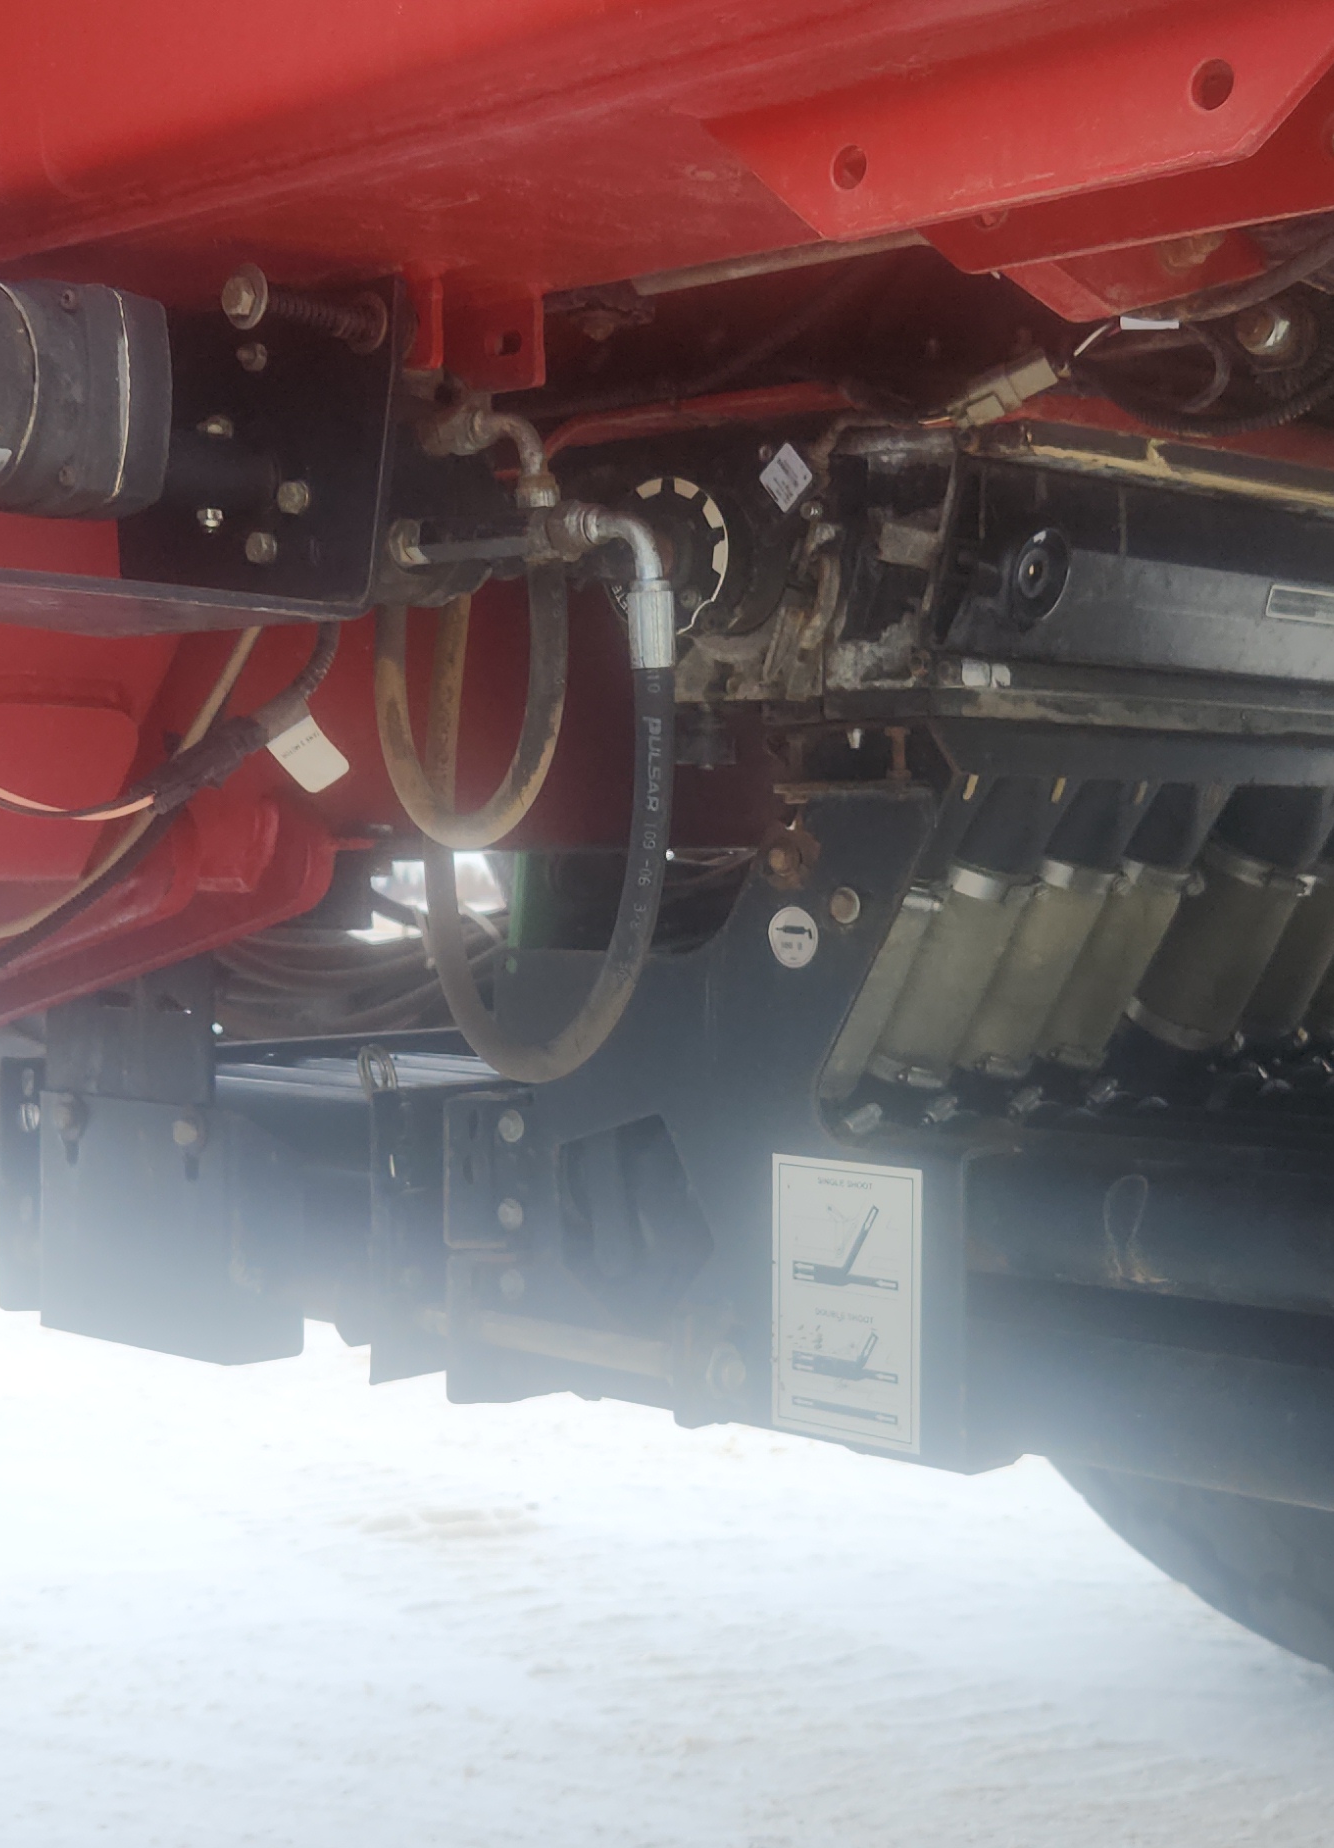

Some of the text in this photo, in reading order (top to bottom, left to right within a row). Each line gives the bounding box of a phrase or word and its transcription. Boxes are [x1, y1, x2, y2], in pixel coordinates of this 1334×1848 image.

[642, 716, 662, 812] PULSAR
[817, 1176, 873, 1190] SINGLE SHOOT
